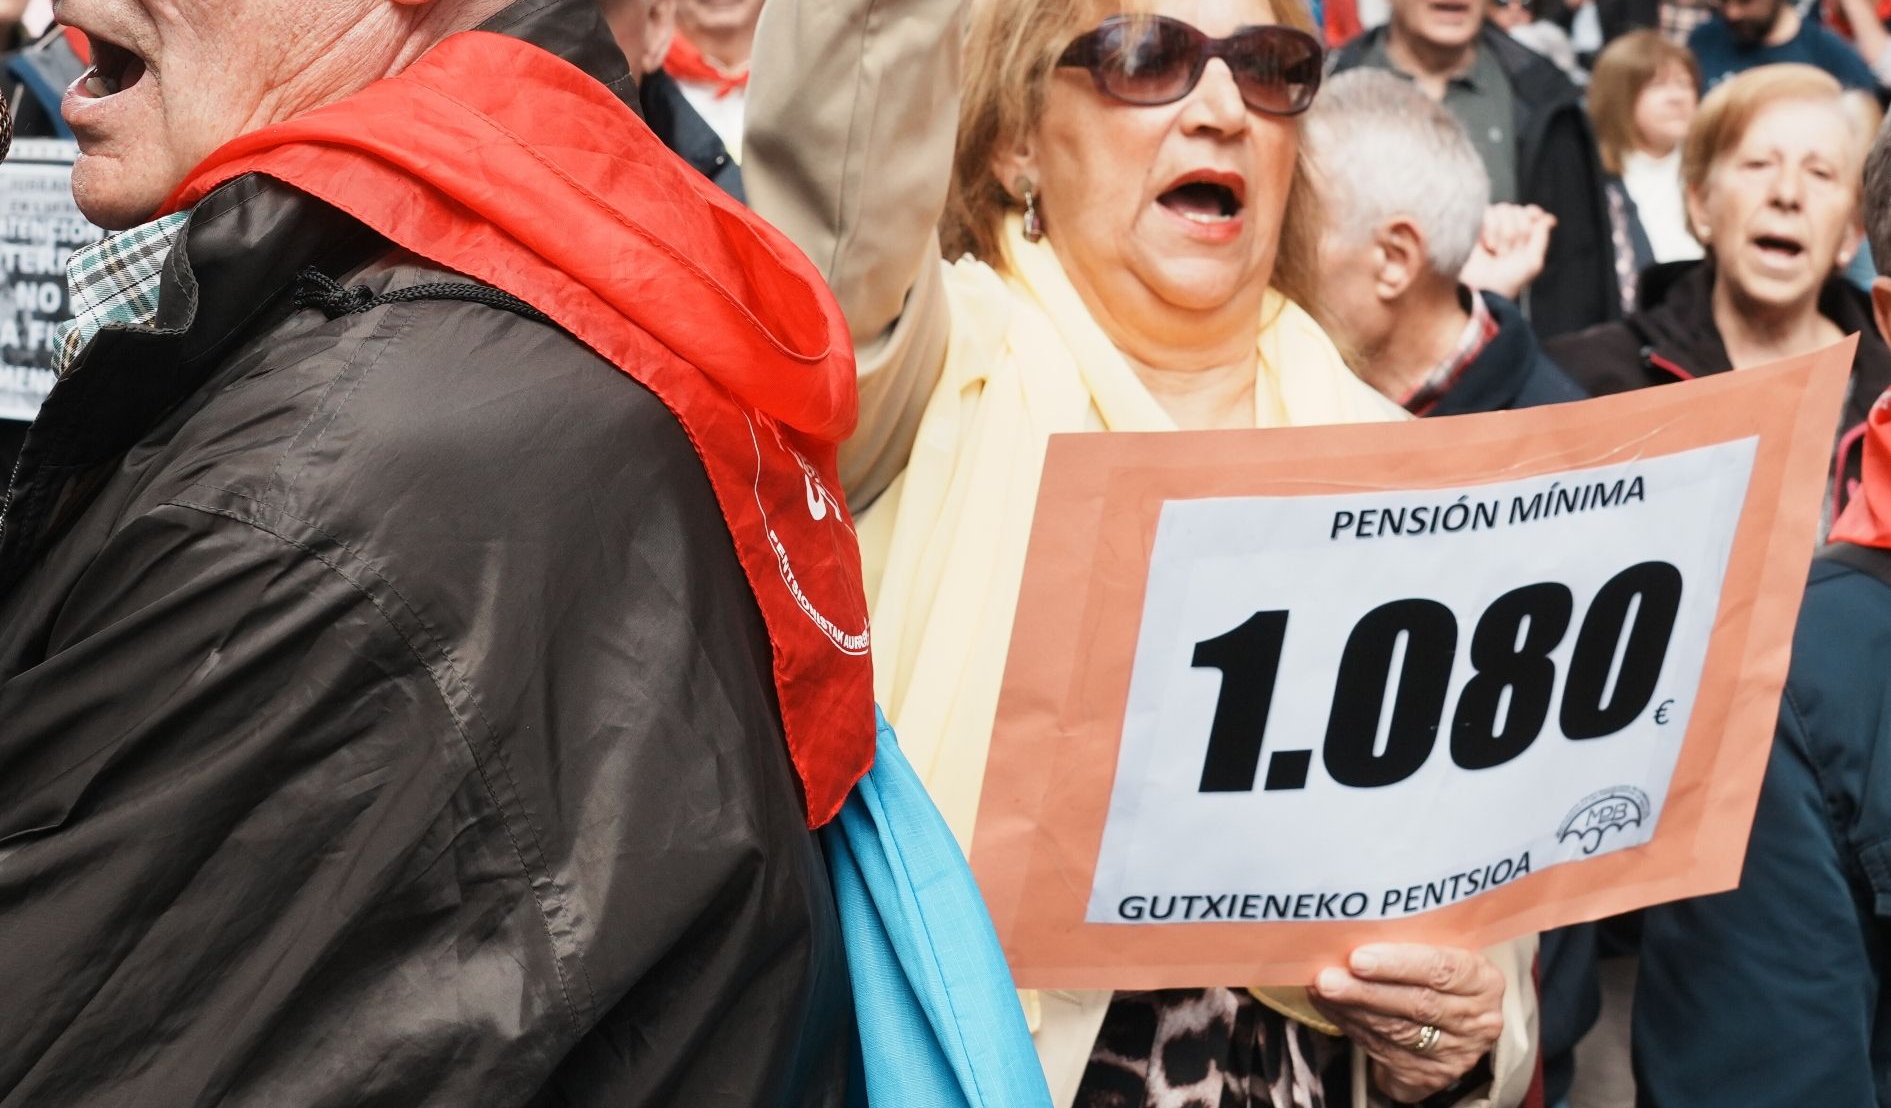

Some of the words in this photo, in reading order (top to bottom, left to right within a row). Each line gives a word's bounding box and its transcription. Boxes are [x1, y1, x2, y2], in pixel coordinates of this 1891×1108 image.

[1331, 494, 1498, 540] PENSIÓN
[1508, 475, 1646, 526] MÍNIMA
[1190, 560, 1684, 794] 1.080
[1653, 699, 1676, 725] €
[1117, 893, 1368, 921] GUTXIENEKO
[1380, 851, 1532, 916] PENTSIOA
